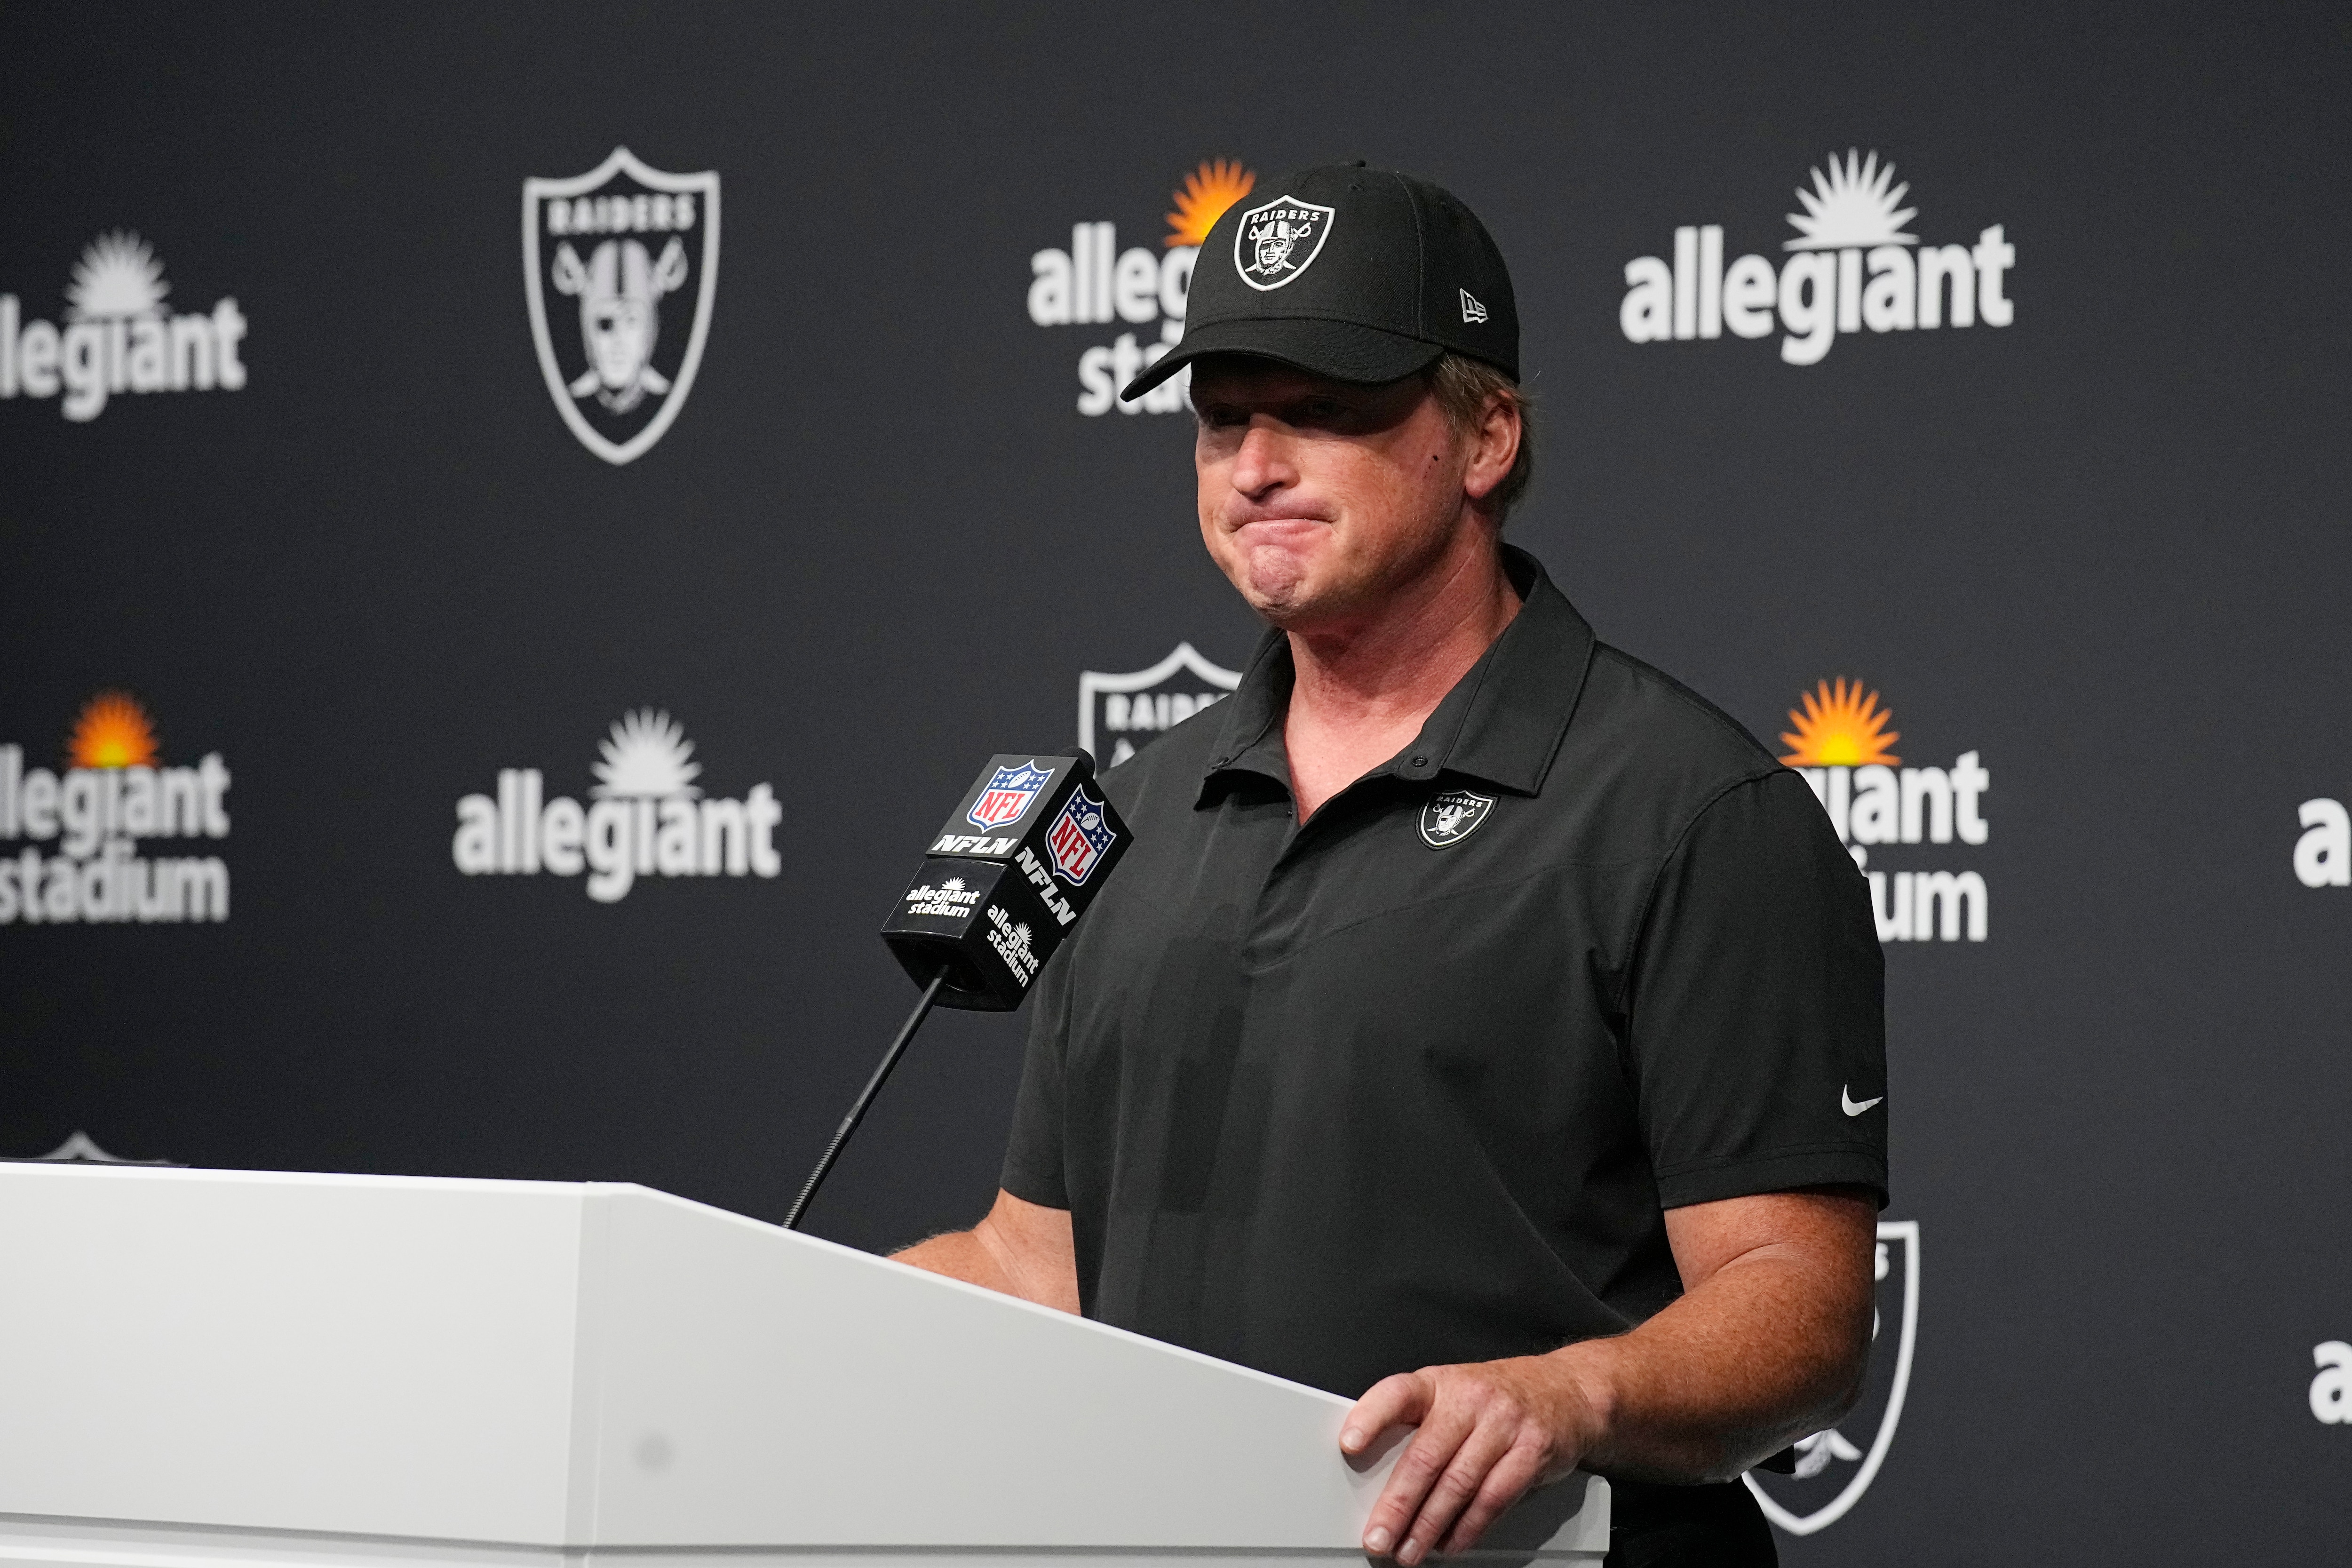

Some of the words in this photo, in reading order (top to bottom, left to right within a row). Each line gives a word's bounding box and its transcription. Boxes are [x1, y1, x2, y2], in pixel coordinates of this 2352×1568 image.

[546, 193, 697, 235] RAIDERS
[1250, 210, 1320, 224] RAIDERS
[1620, 223, 2016, 366] allegiant
[1077, 332, 1191, 416] sta
[1105, 692, 1230, 731] RAID
[0, 742, 231, 858] legiant
[974, 792, 1026, 822] NFL
[1436, 796, 1483, 807] RAIDERS
[1797, 750, 1989, 845] iant
[452, 767, 782, 903] allegiant
[931, 835, 1018, 855] NFLN
[1052, 815, 1091, 877] NFL
[906, 885, 980, 904] allegiant
[908, 901, 970, 918] stadium
[1015, 846, 1076, 926] NFLN
[1852, 845, 1988, 942] um
[987, 904, 1039, 974] allegiant
[987, 930, 1028, 987] stadium
